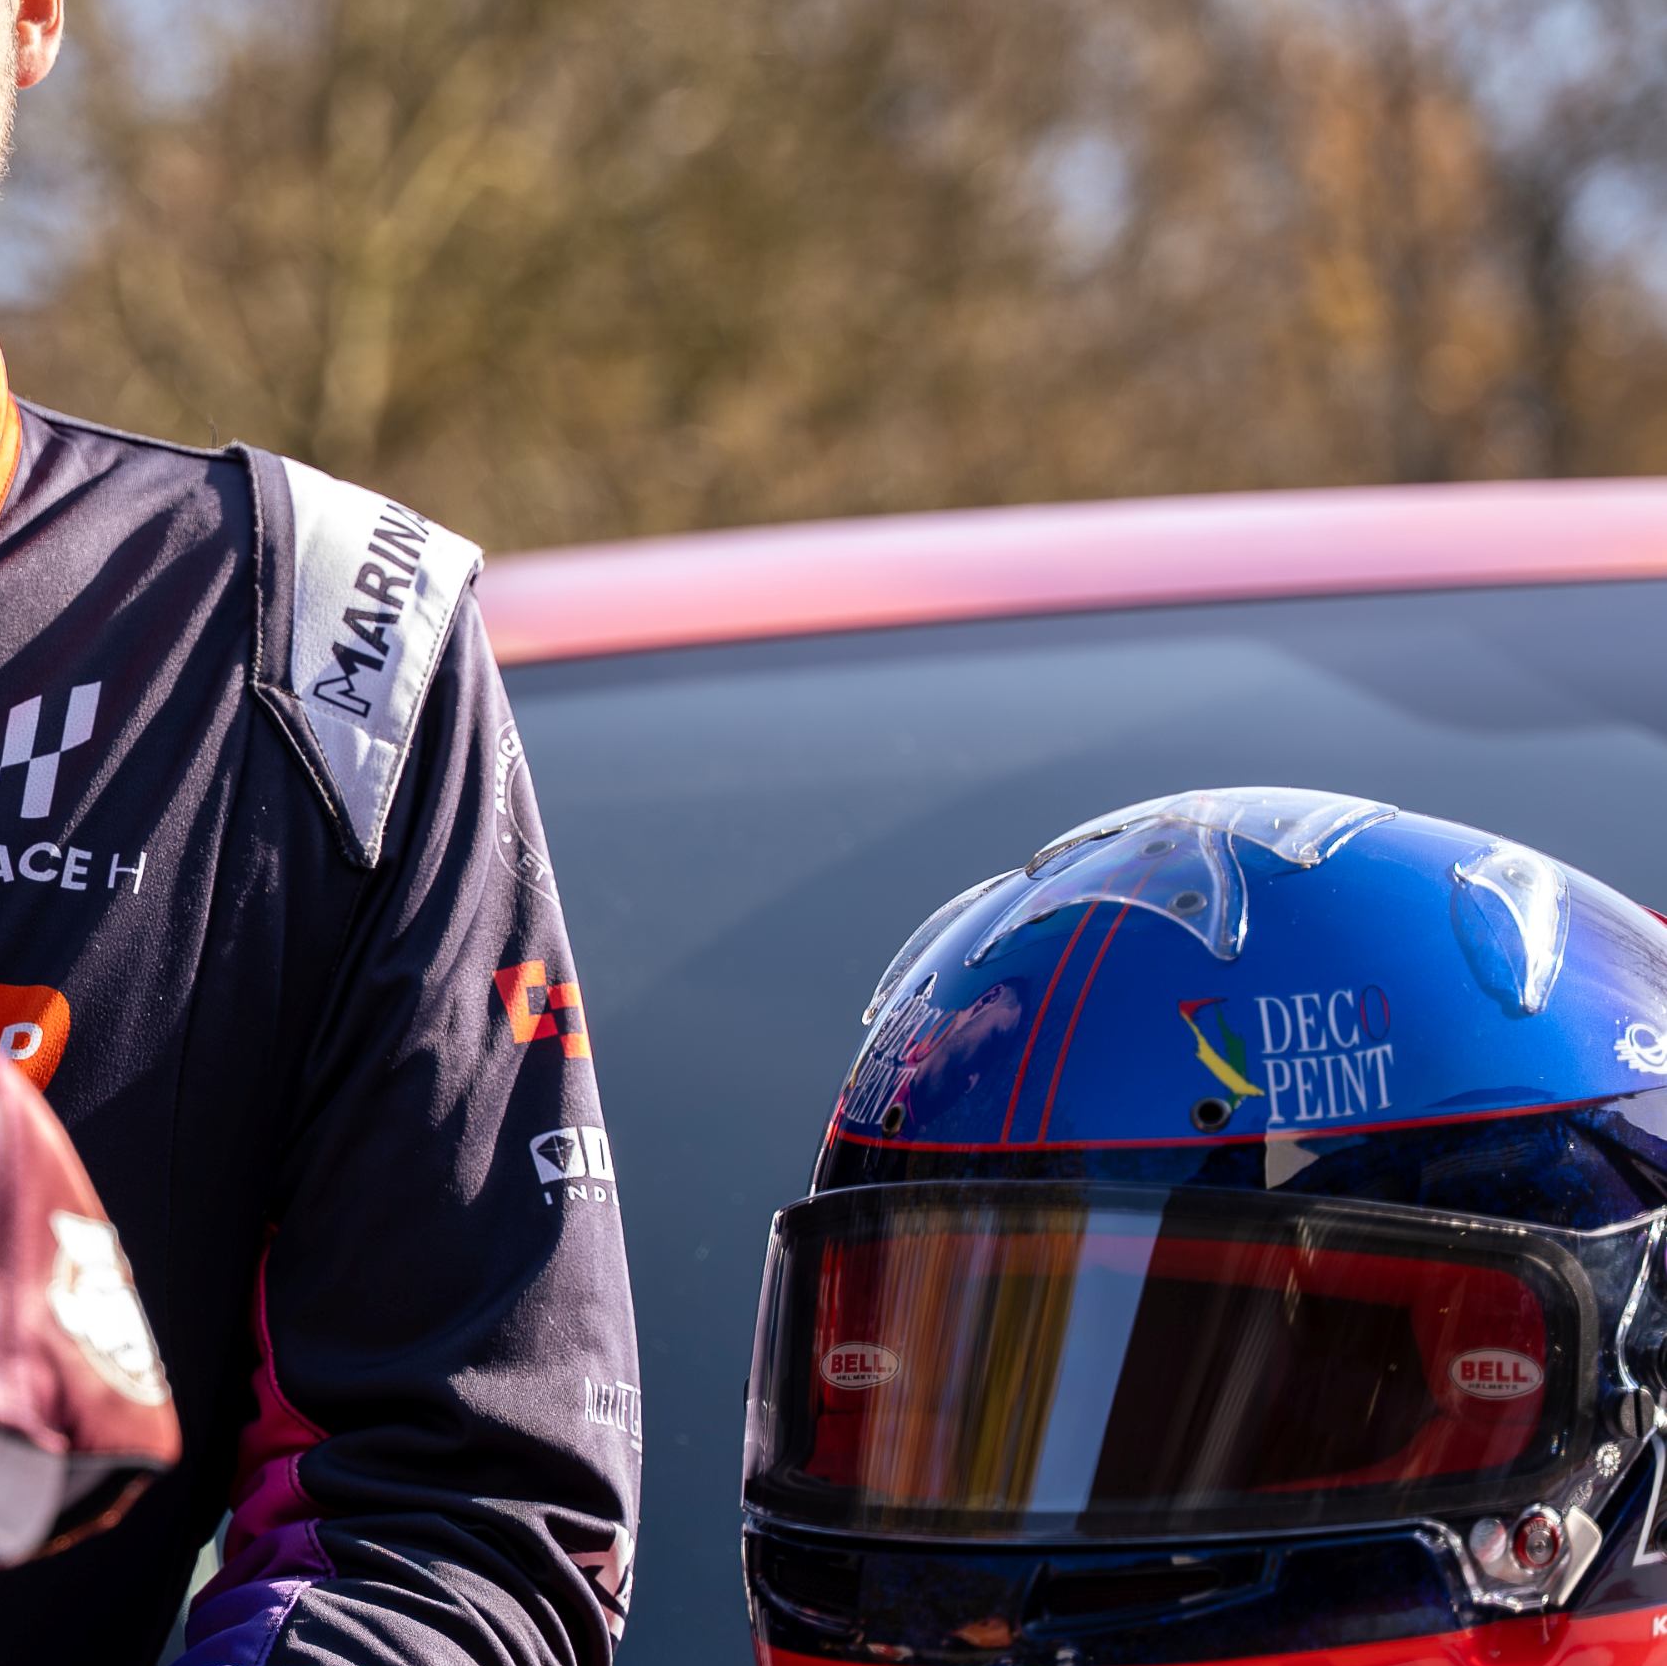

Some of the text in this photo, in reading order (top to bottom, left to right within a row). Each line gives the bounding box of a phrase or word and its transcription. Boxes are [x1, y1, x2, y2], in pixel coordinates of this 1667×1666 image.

[107, 851, 147, 895] H
[1254, 984, 1391, 1055] DECO
[1262, 1043, 1394, 1124] PEINT
[831, 1353, 887, 1374] BELL
[1461, 1360, 1528, 1383] BELL
